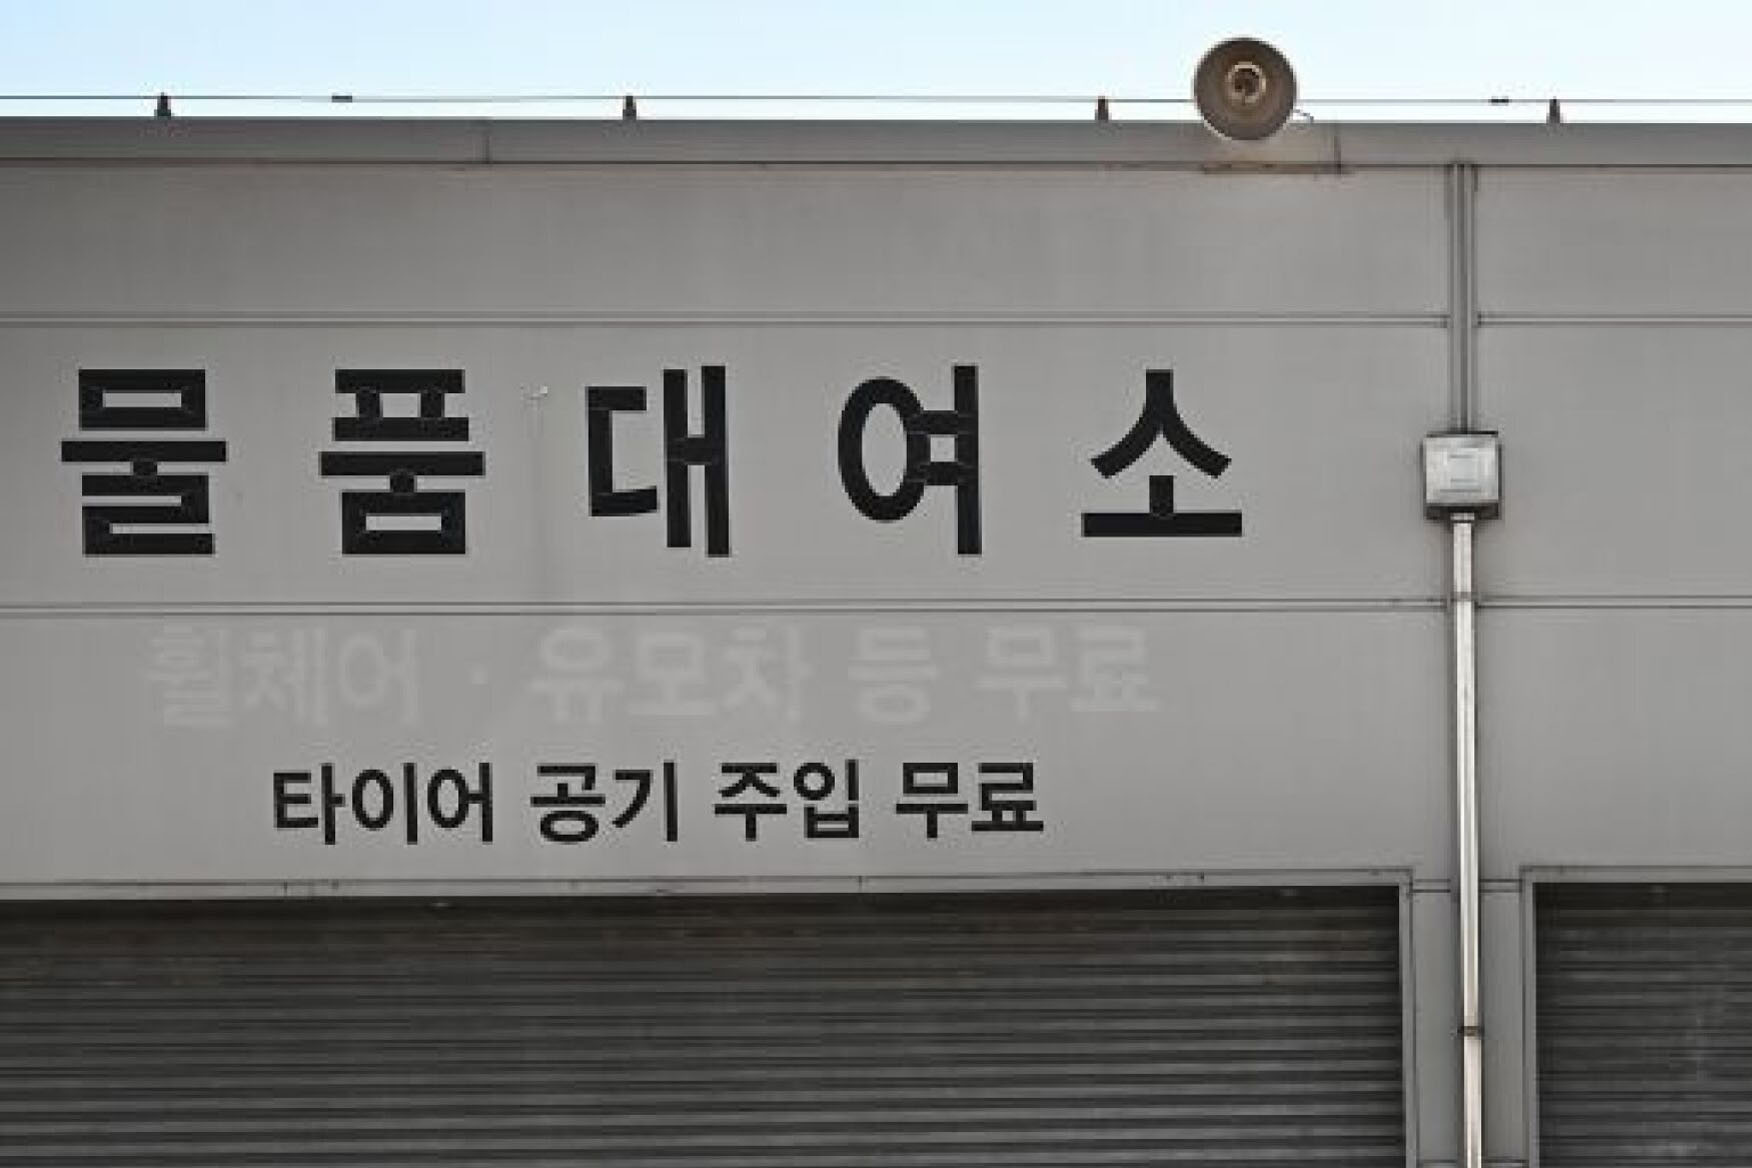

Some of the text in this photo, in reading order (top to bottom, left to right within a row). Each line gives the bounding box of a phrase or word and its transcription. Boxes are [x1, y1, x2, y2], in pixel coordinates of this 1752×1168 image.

[527, 624, 812, 724] 유모차
[847, 625, 938, 725] 등
[973, 624, 1161, 720] 무료
[273, 758, 1045, 846] 타이어 공기 주입 무료
